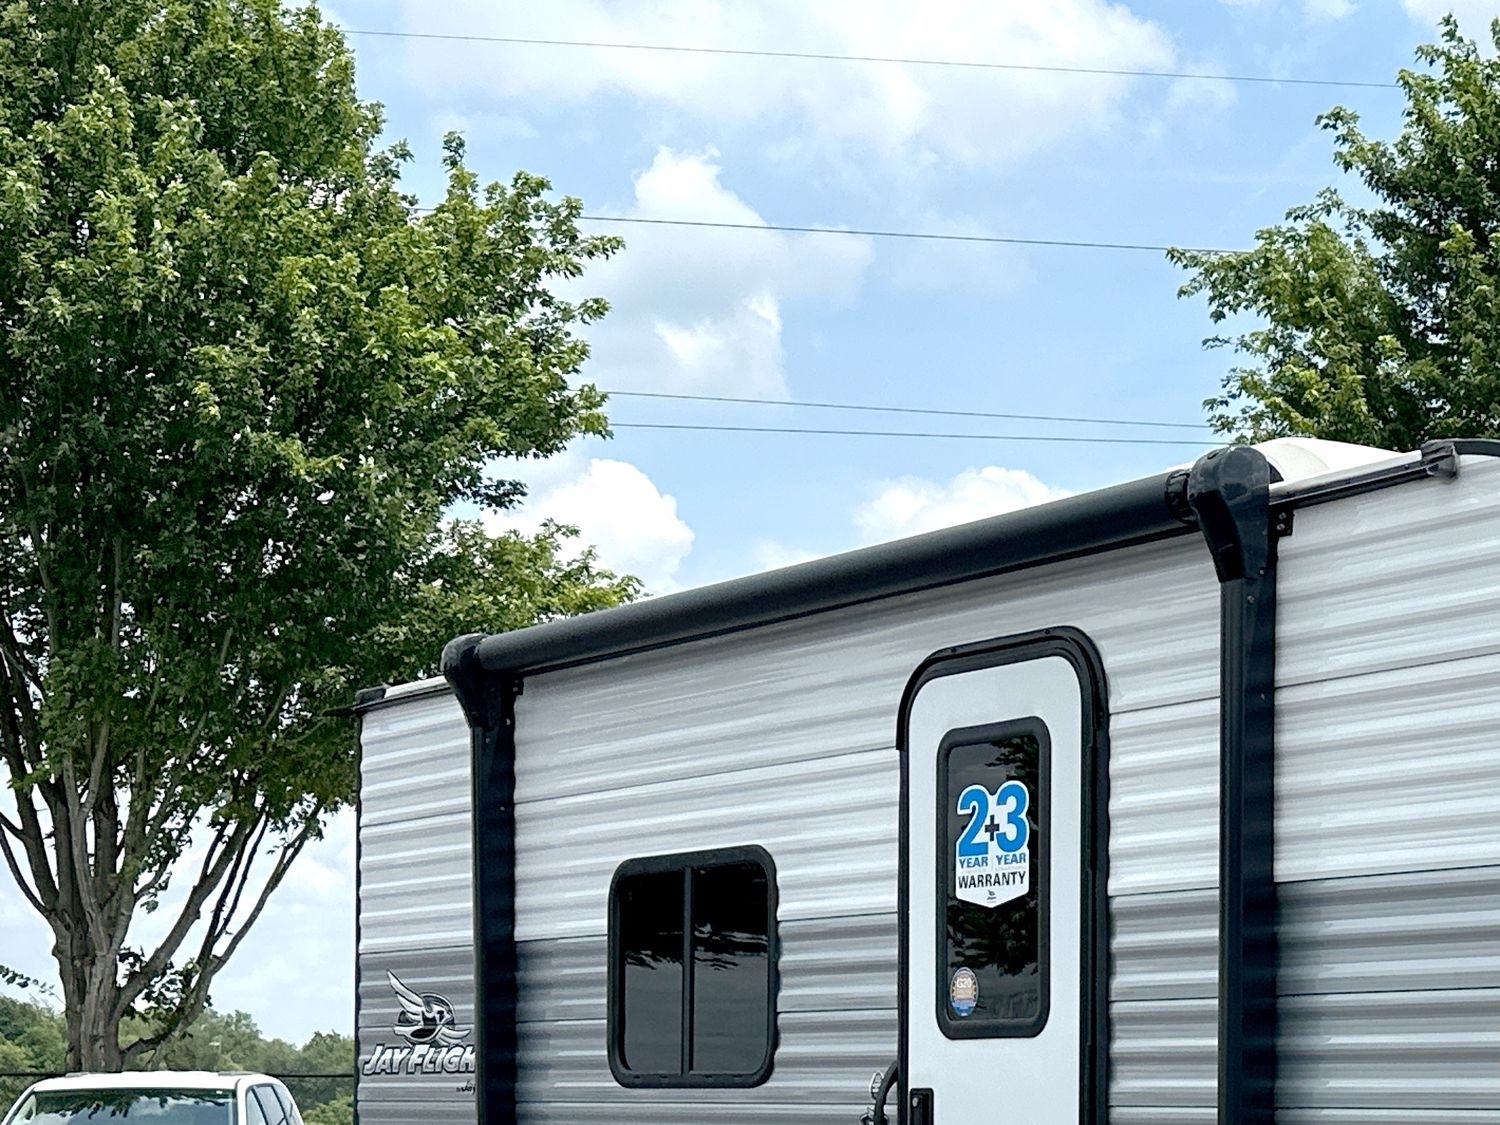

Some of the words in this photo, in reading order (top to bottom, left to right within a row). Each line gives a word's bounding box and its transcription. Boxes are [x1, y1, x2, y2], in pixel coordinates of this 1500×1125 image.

[959, 856, 989, 869] YEAR
[996, 852, 1026, 866] YEAR
[958, 871, 1026, 889] WARRANTY
[363, 1043, 411, 1075] JAY
[406, 1043, 476, 1074] FLIGH
